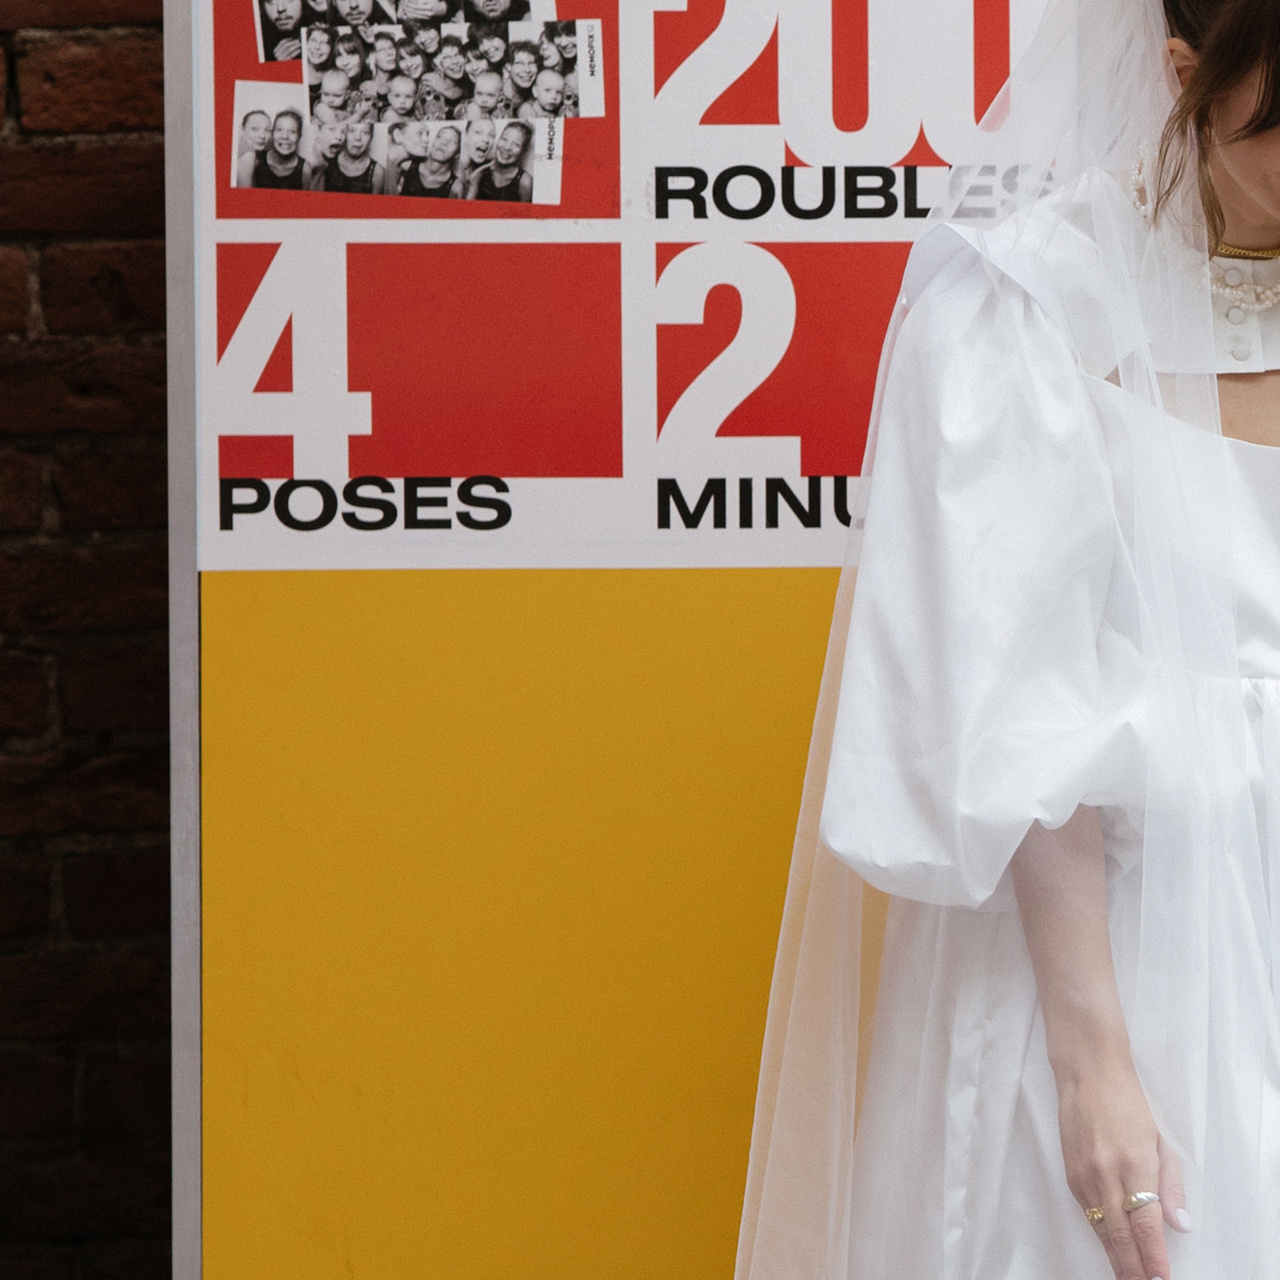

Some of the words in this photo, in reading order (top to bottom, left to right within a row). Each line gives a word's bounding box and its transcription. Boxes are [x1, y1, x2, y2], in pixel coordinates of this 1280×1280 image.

[216, 242, 372, 478] 4
[655, 241, 801, 477] 2
[219, 475, 512, 531] POSES
[657, 475, 853, 529] MINU
